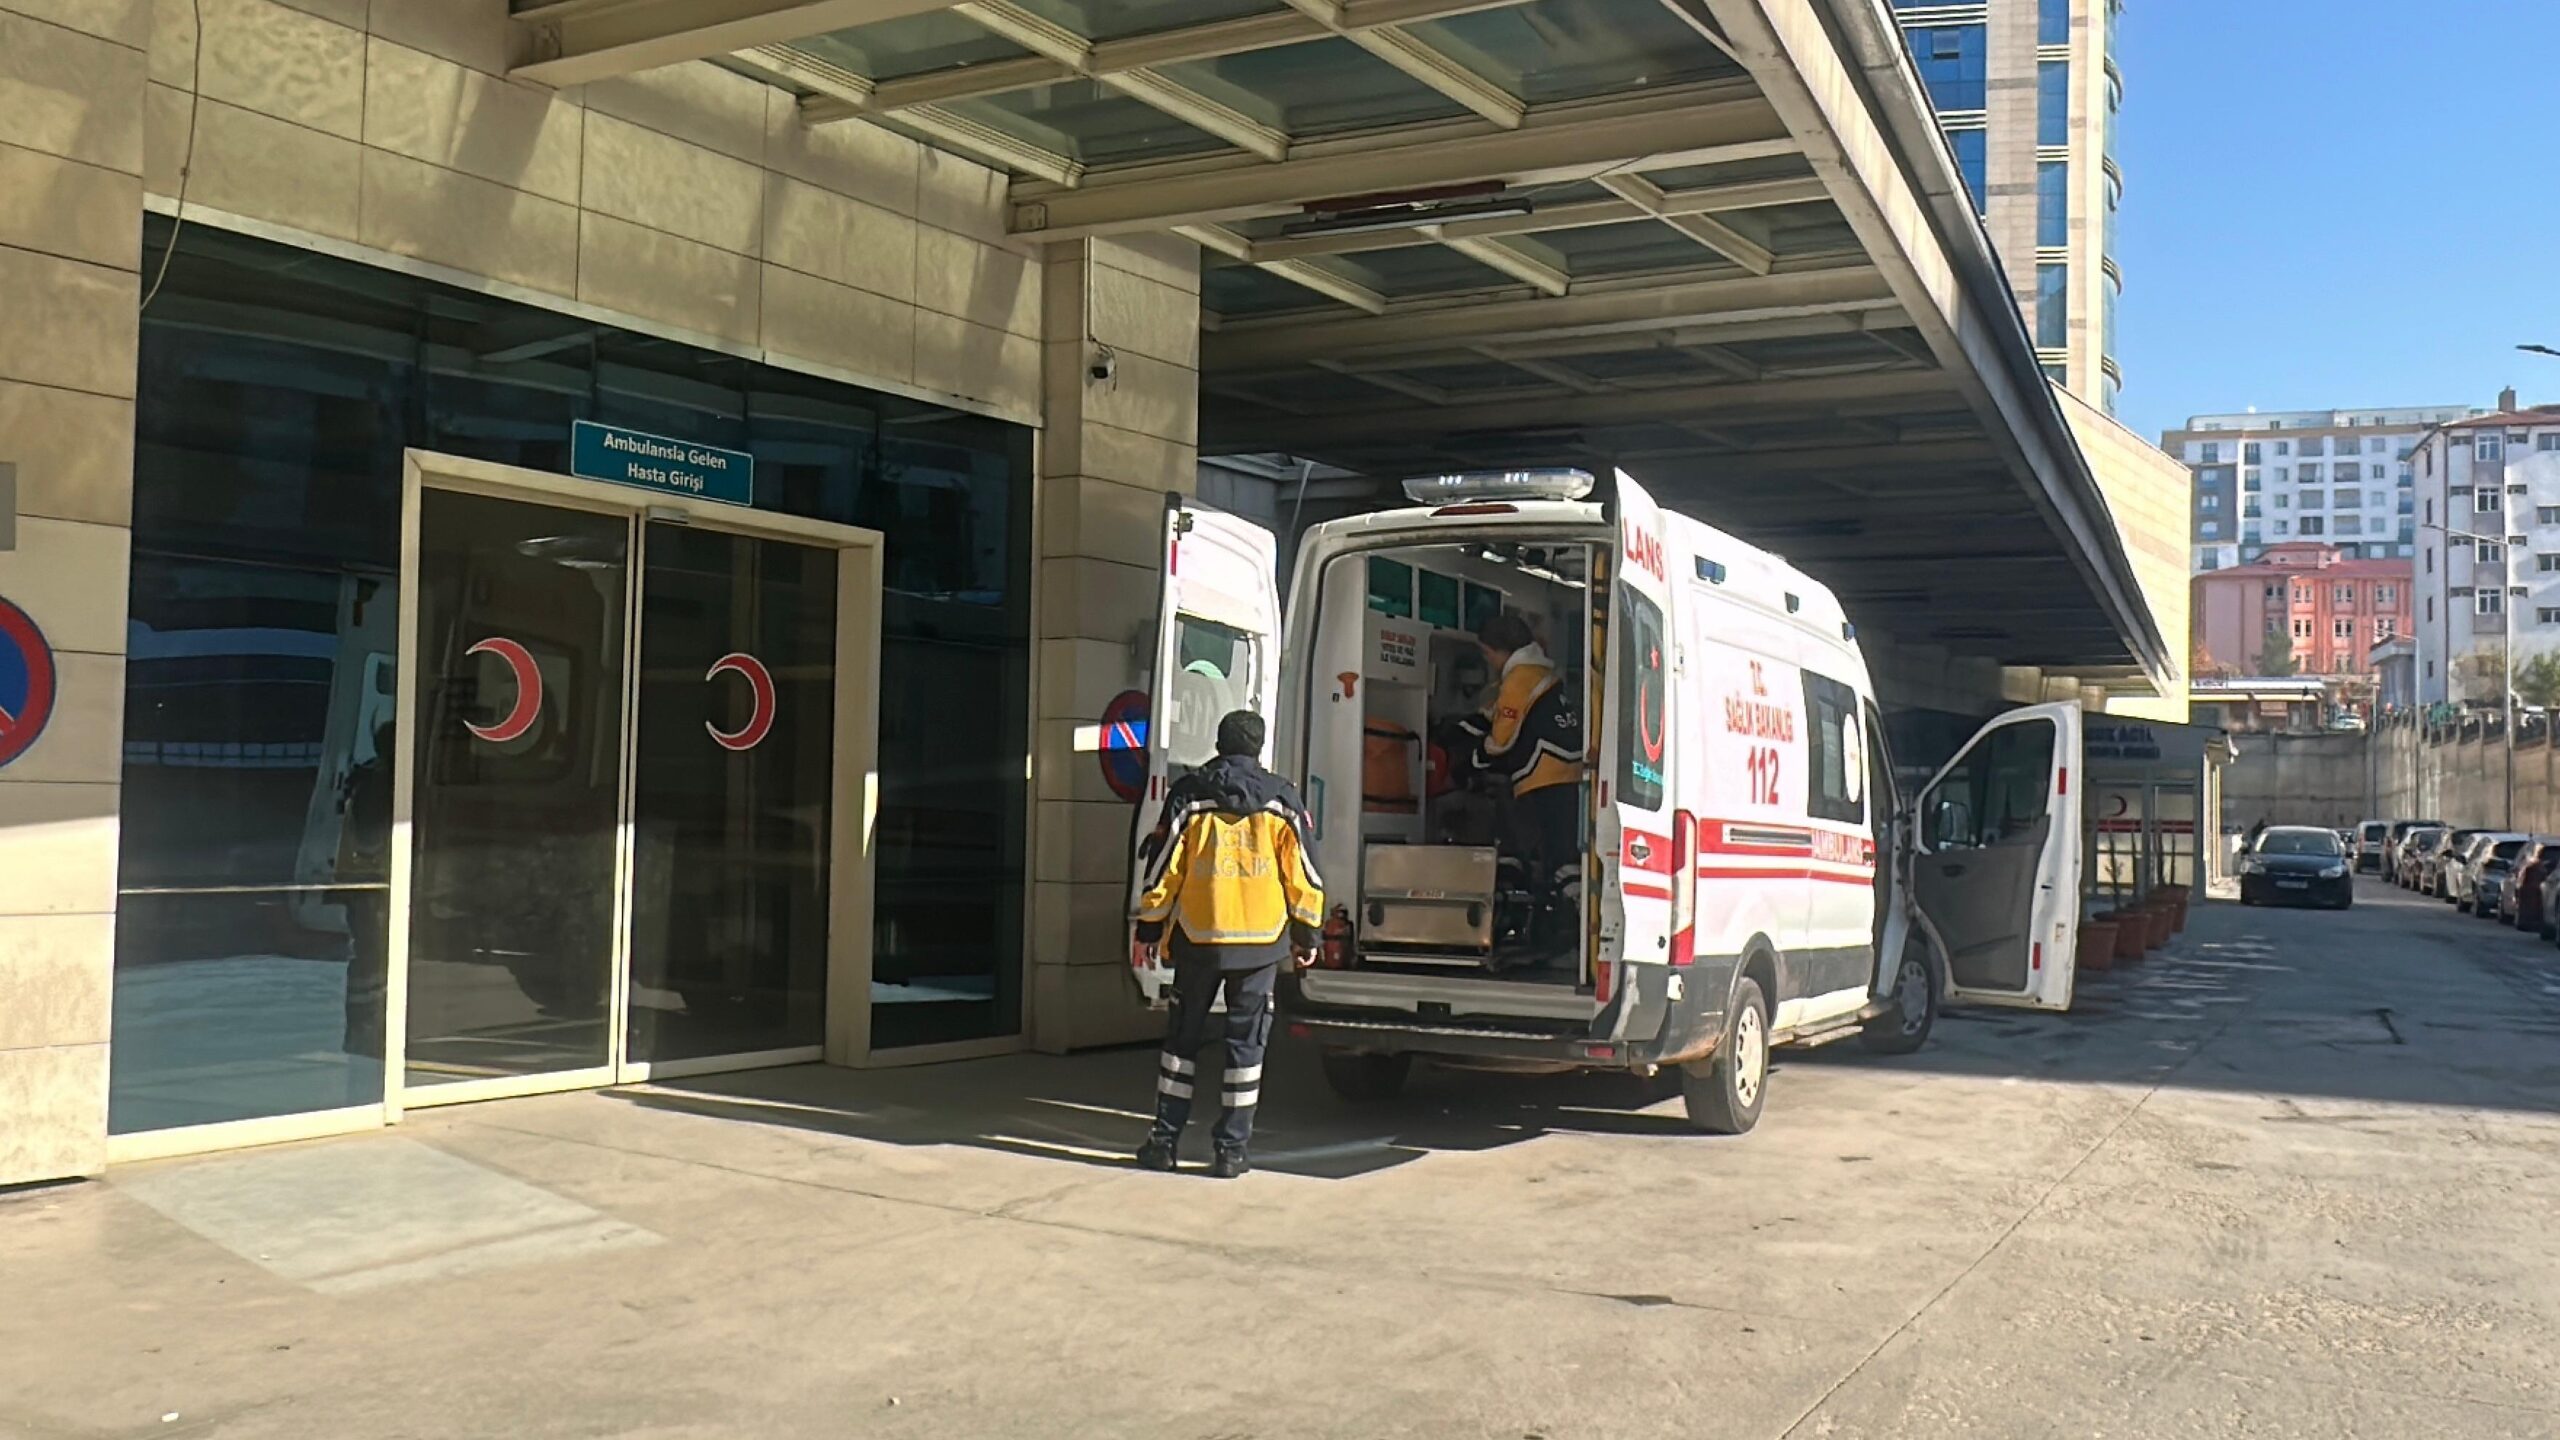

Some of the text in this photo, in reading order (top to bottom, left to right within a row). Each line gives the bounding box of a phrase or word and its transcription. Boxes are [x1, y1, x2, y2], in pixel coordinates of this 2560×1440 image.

[628, 462, 704, 493] Hasta Girişi
[688, 449, 727, 470] Gelen
[1623, 516, 1663, 582] LANS
[1725, 690, 1754, 736] SAĞLIK
[1747, 745, 1779, 805] 112
